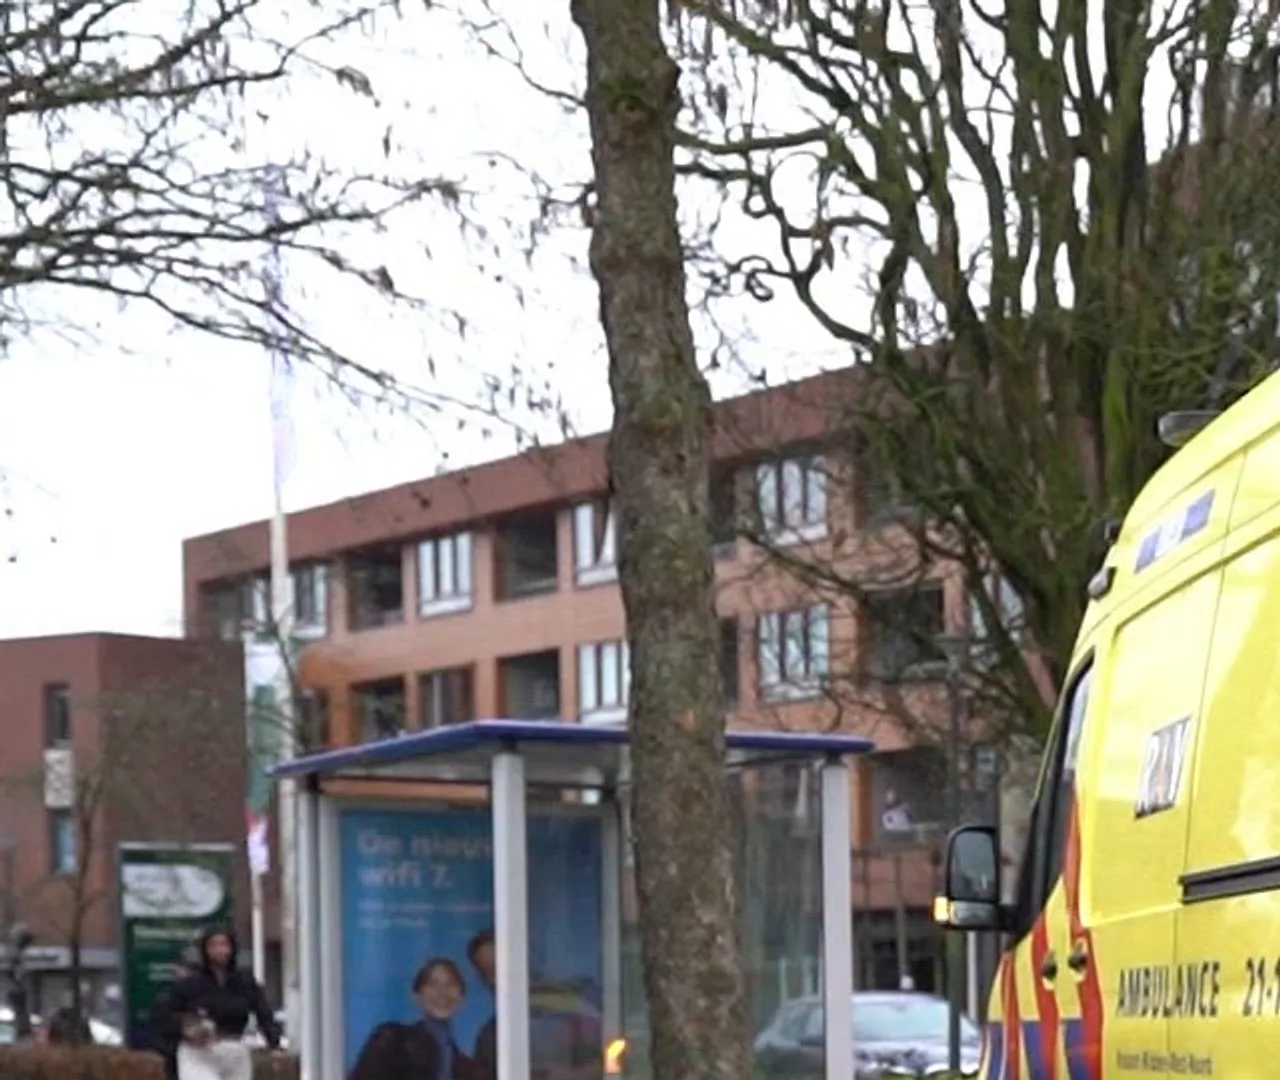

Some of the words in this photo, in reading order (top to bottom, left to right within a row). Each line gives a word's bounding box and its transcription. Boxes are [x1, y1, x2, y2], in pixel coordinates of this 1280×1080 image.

[410, 833, 492, 859] nieu
[357, 860, 421, 888] wifi
[1116, 960, 1221, 1018] AMBULANCE
